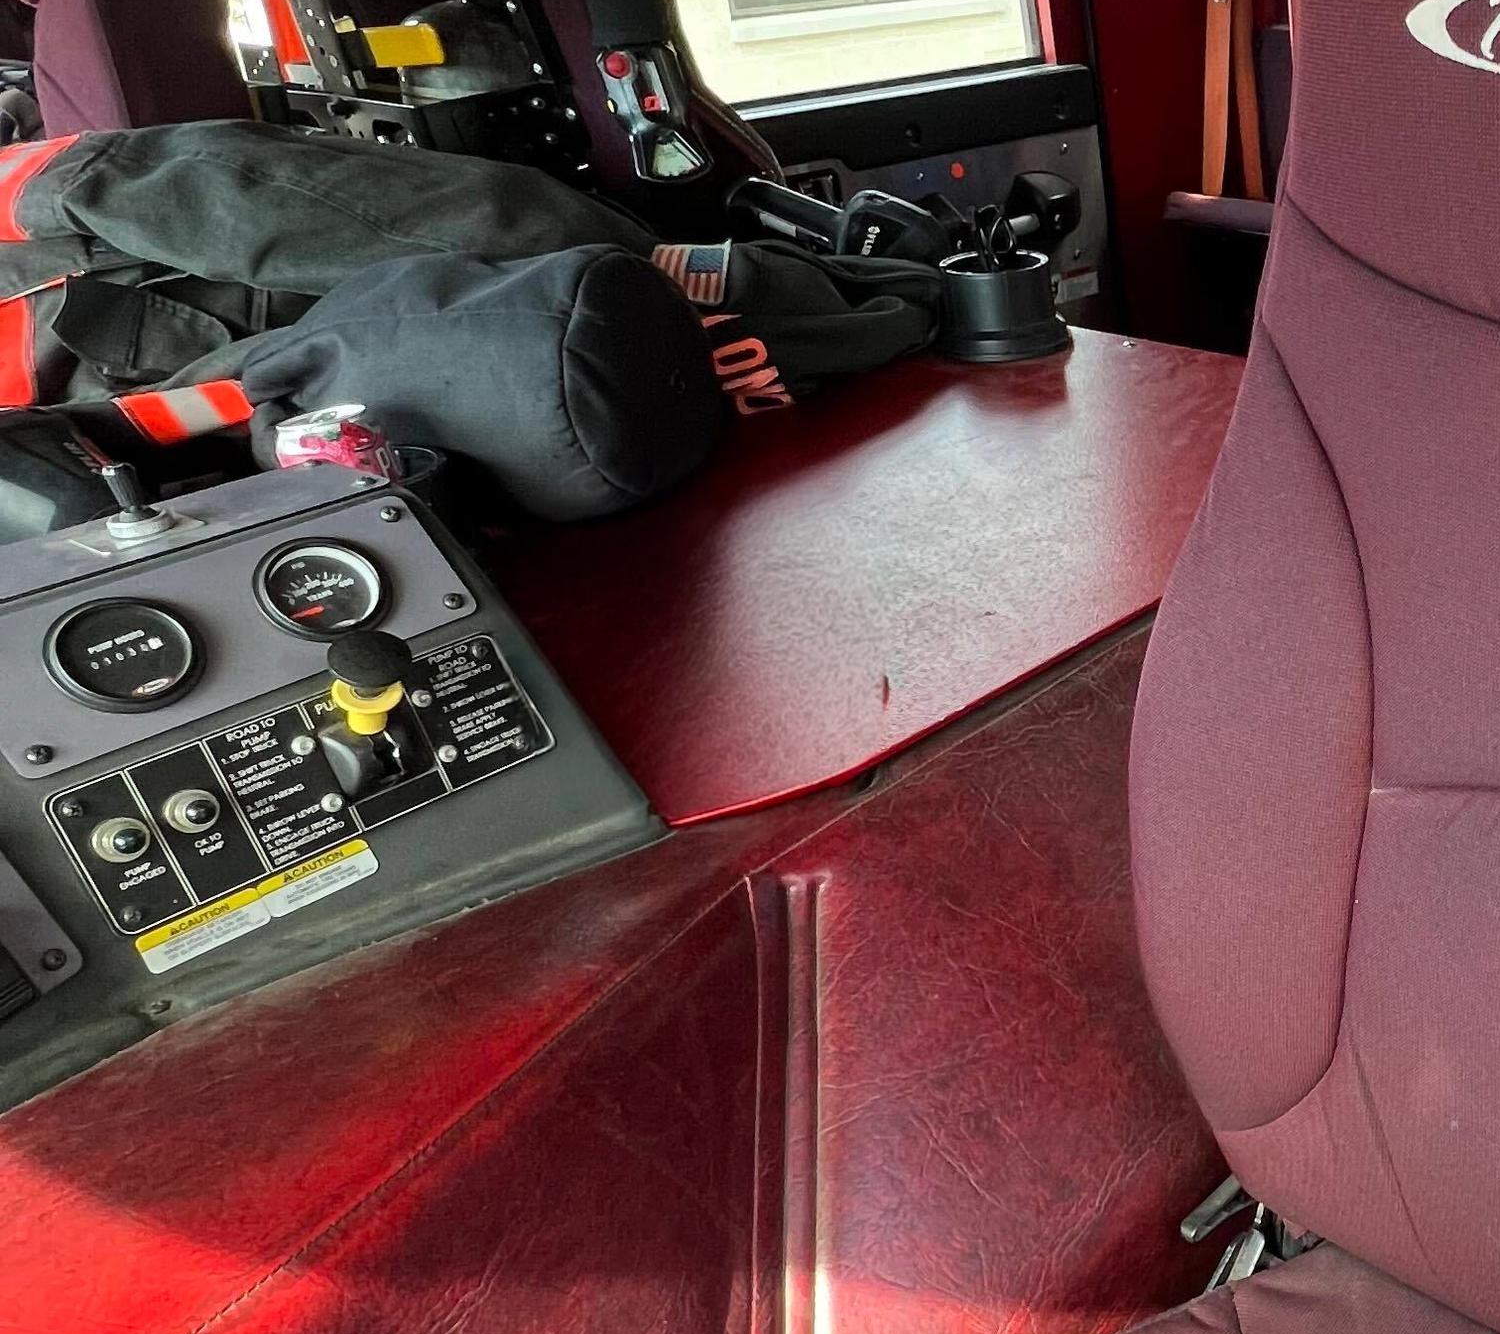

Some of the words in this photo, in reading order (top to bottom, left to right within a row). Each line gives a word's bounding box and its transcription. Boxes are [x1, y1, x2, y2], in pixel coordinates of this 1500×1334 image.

[427, 649, 454, 665] PUMP
[454, 644, 468, 655] TO
[438, 656, 468, 672] ROAD
[225, 723, 260, 743] ROAD
[260, 717, 276, 729] TO
[240, 730, 271, 748] PUMP
[228, 748, 250, 763] STOP
[251, 737, 279, 753] TRUCK
[257, 754, 286, 769] TRUCK
[232, 760, 292, 788] TRANSMISSION
[290, 755, 304, 766] TO
[267, 783, 306, 803] PARKING
[208, 832, 222, 842] TO
[269, 828, 327, 858] TRANSMISSION
[274, 826, 310, 847] ENGAGE
[310, 816, 336, 832] TRUCK
[200, 840, 225, 856] PUMP
[124, 862, 151, 878] PUMP
[292, 849, 345, 878] CAUTION
[119, 866, 167, 891] ENGAGED
[178, 902, 231, 931] CAUTION
